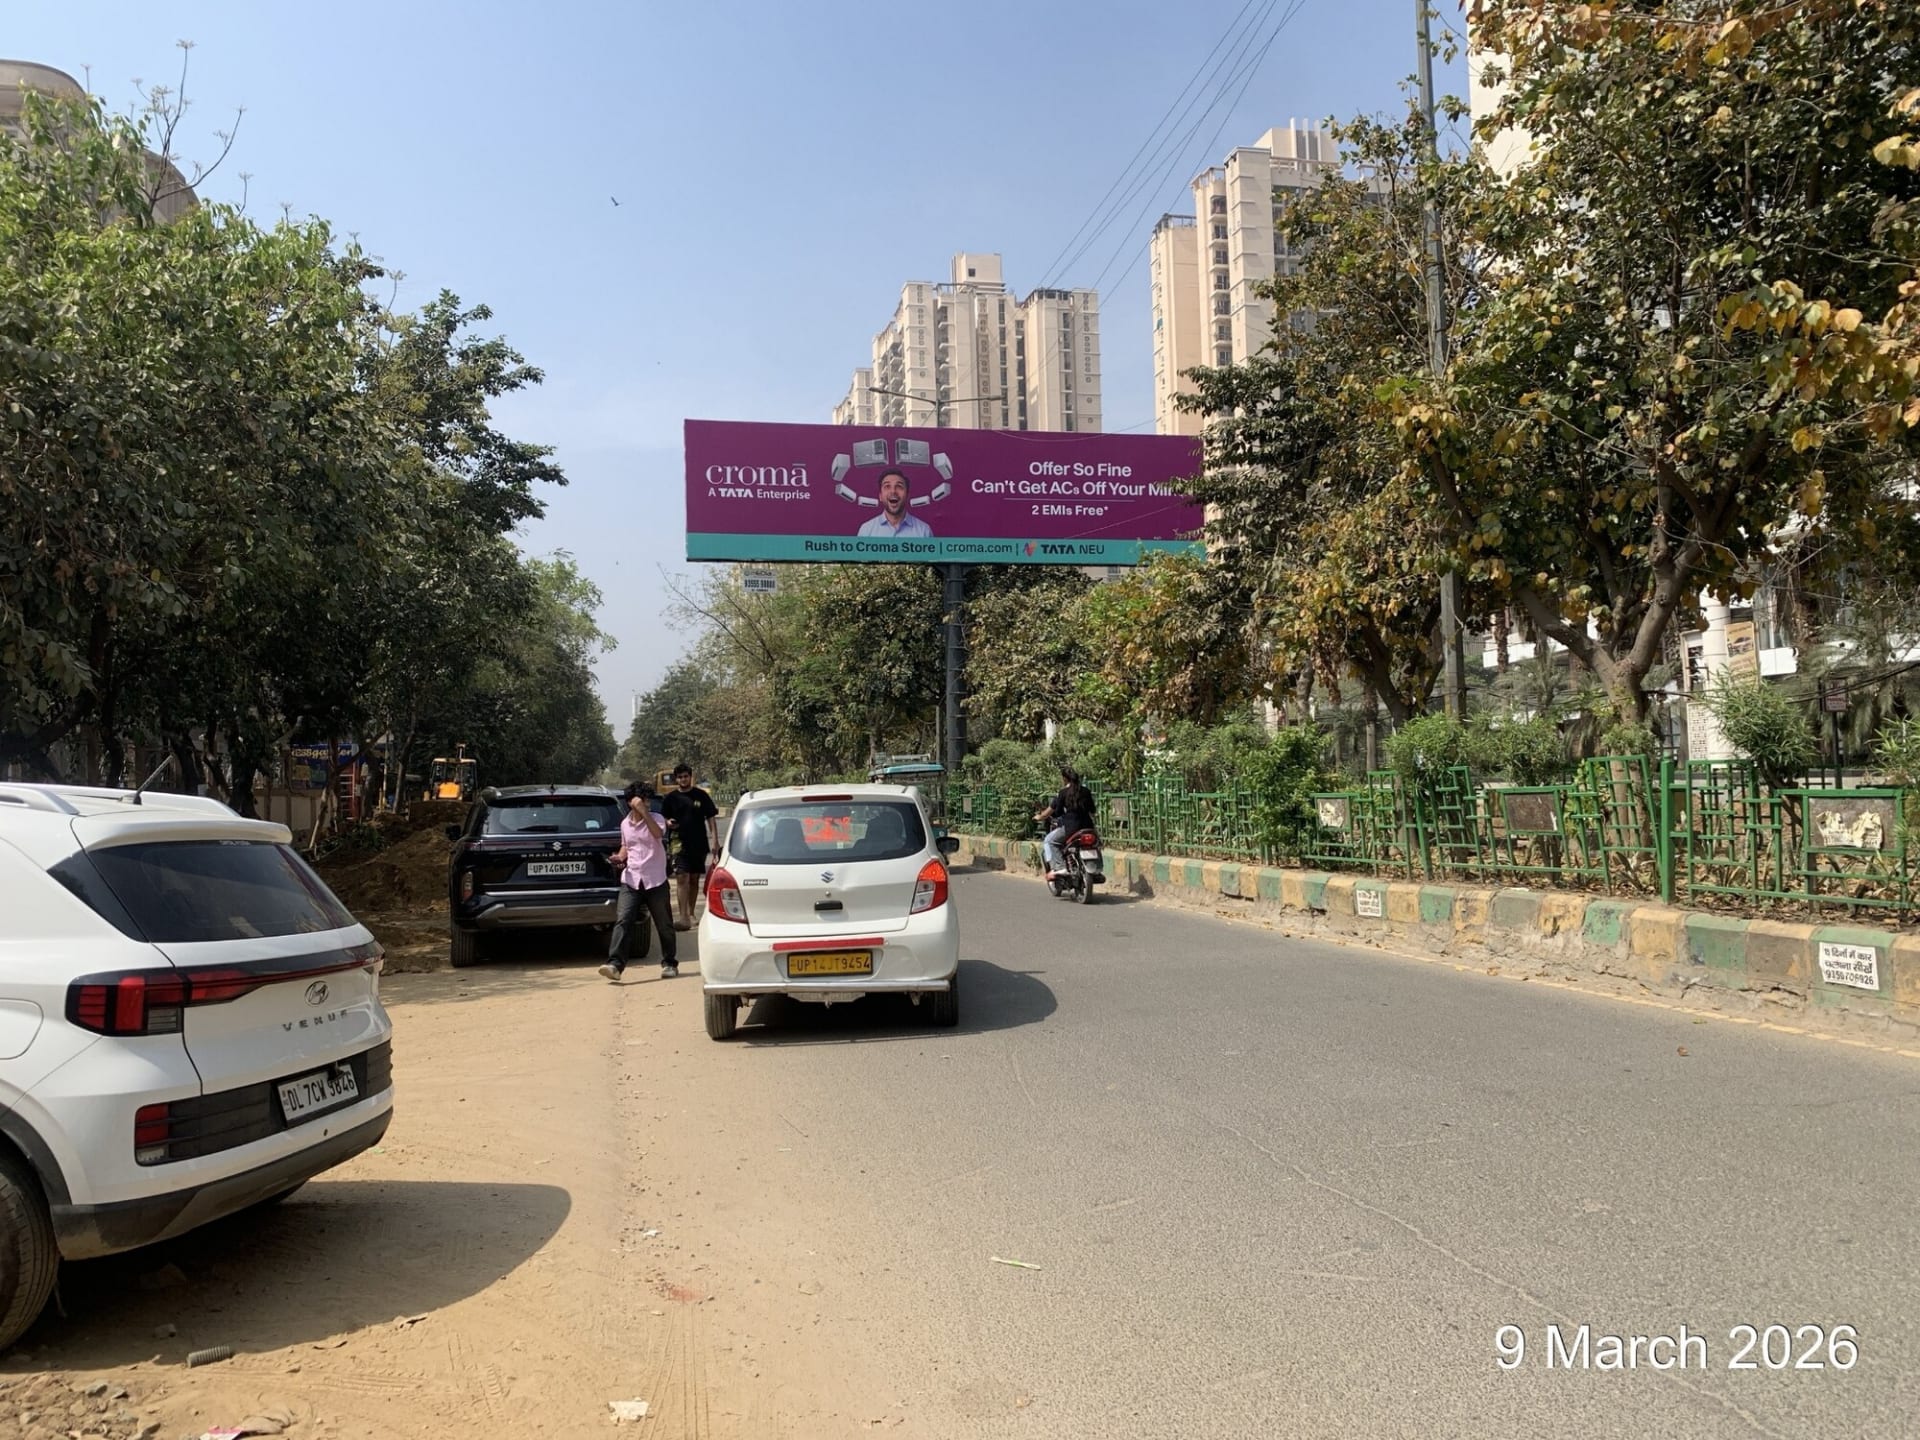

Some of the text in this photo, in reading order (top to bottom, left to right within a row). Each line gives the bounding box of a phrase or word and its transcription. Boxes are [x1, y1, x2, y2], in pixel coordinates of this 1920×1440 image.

[1029, 461, 1132, 477] Offer So Fine
[708, 487, 811, 501] A TATA Enterprise
[971, 479, 1015, 494] Can't
[1018, 480, 1047, 495] Get
[1050, 481, 1080, 495] ACs
[1082, 481, 1108, 496] Off
[1109, 482, 1146, 496] Your
[1031, 505, 1039, 516] 2
[1042, 504, 1073, 516] EMIs
[805, 540, 936, 553] Rush to Croma Store
[946, 543, 1013, 553] croma.com
[1040, 544, 1105, 555] TATA NEU
